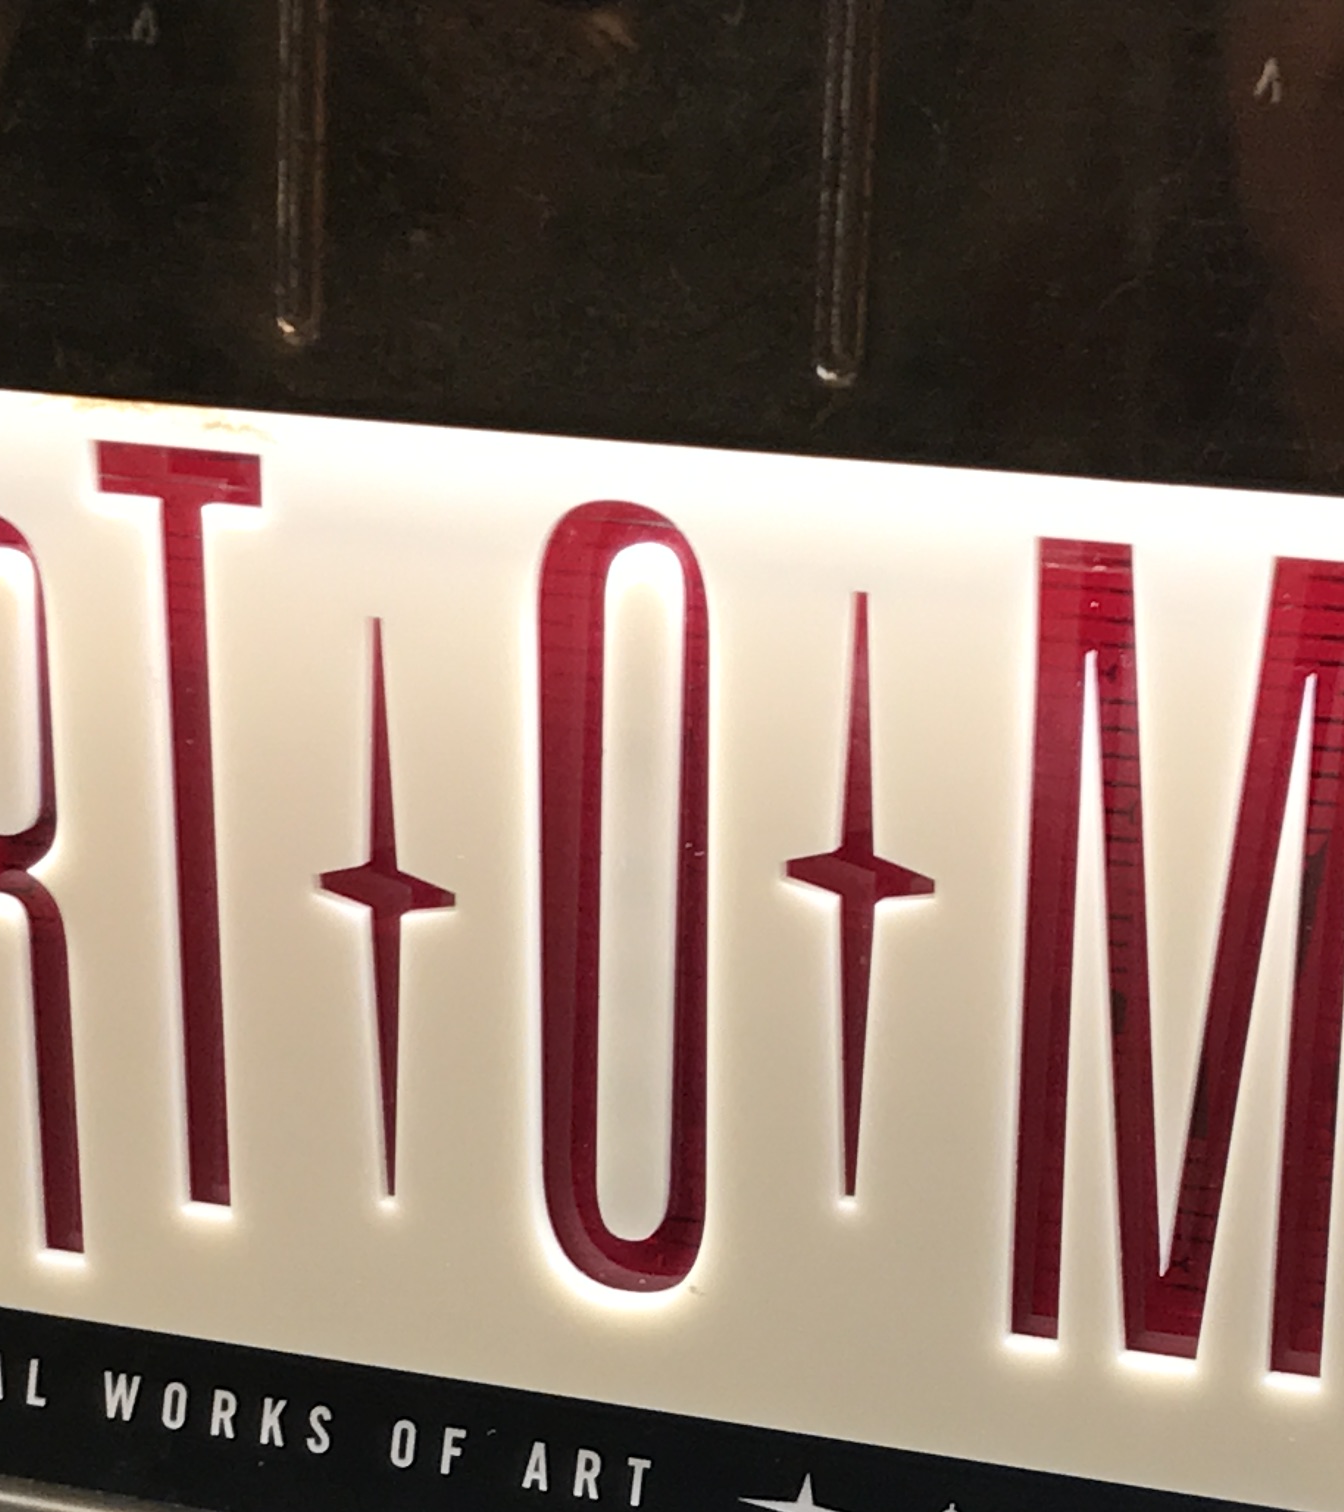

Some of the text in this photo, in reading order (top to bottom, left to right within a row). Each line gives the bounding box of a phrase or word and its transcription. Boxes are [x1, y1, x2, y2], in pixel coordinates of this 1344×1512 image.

[537, 499, 710, 1292] O
[103, 1369, 333, 1454] WORKS
[389, 1419, 468, 1476] OF
[522, 1441, 653, 1508] ART
